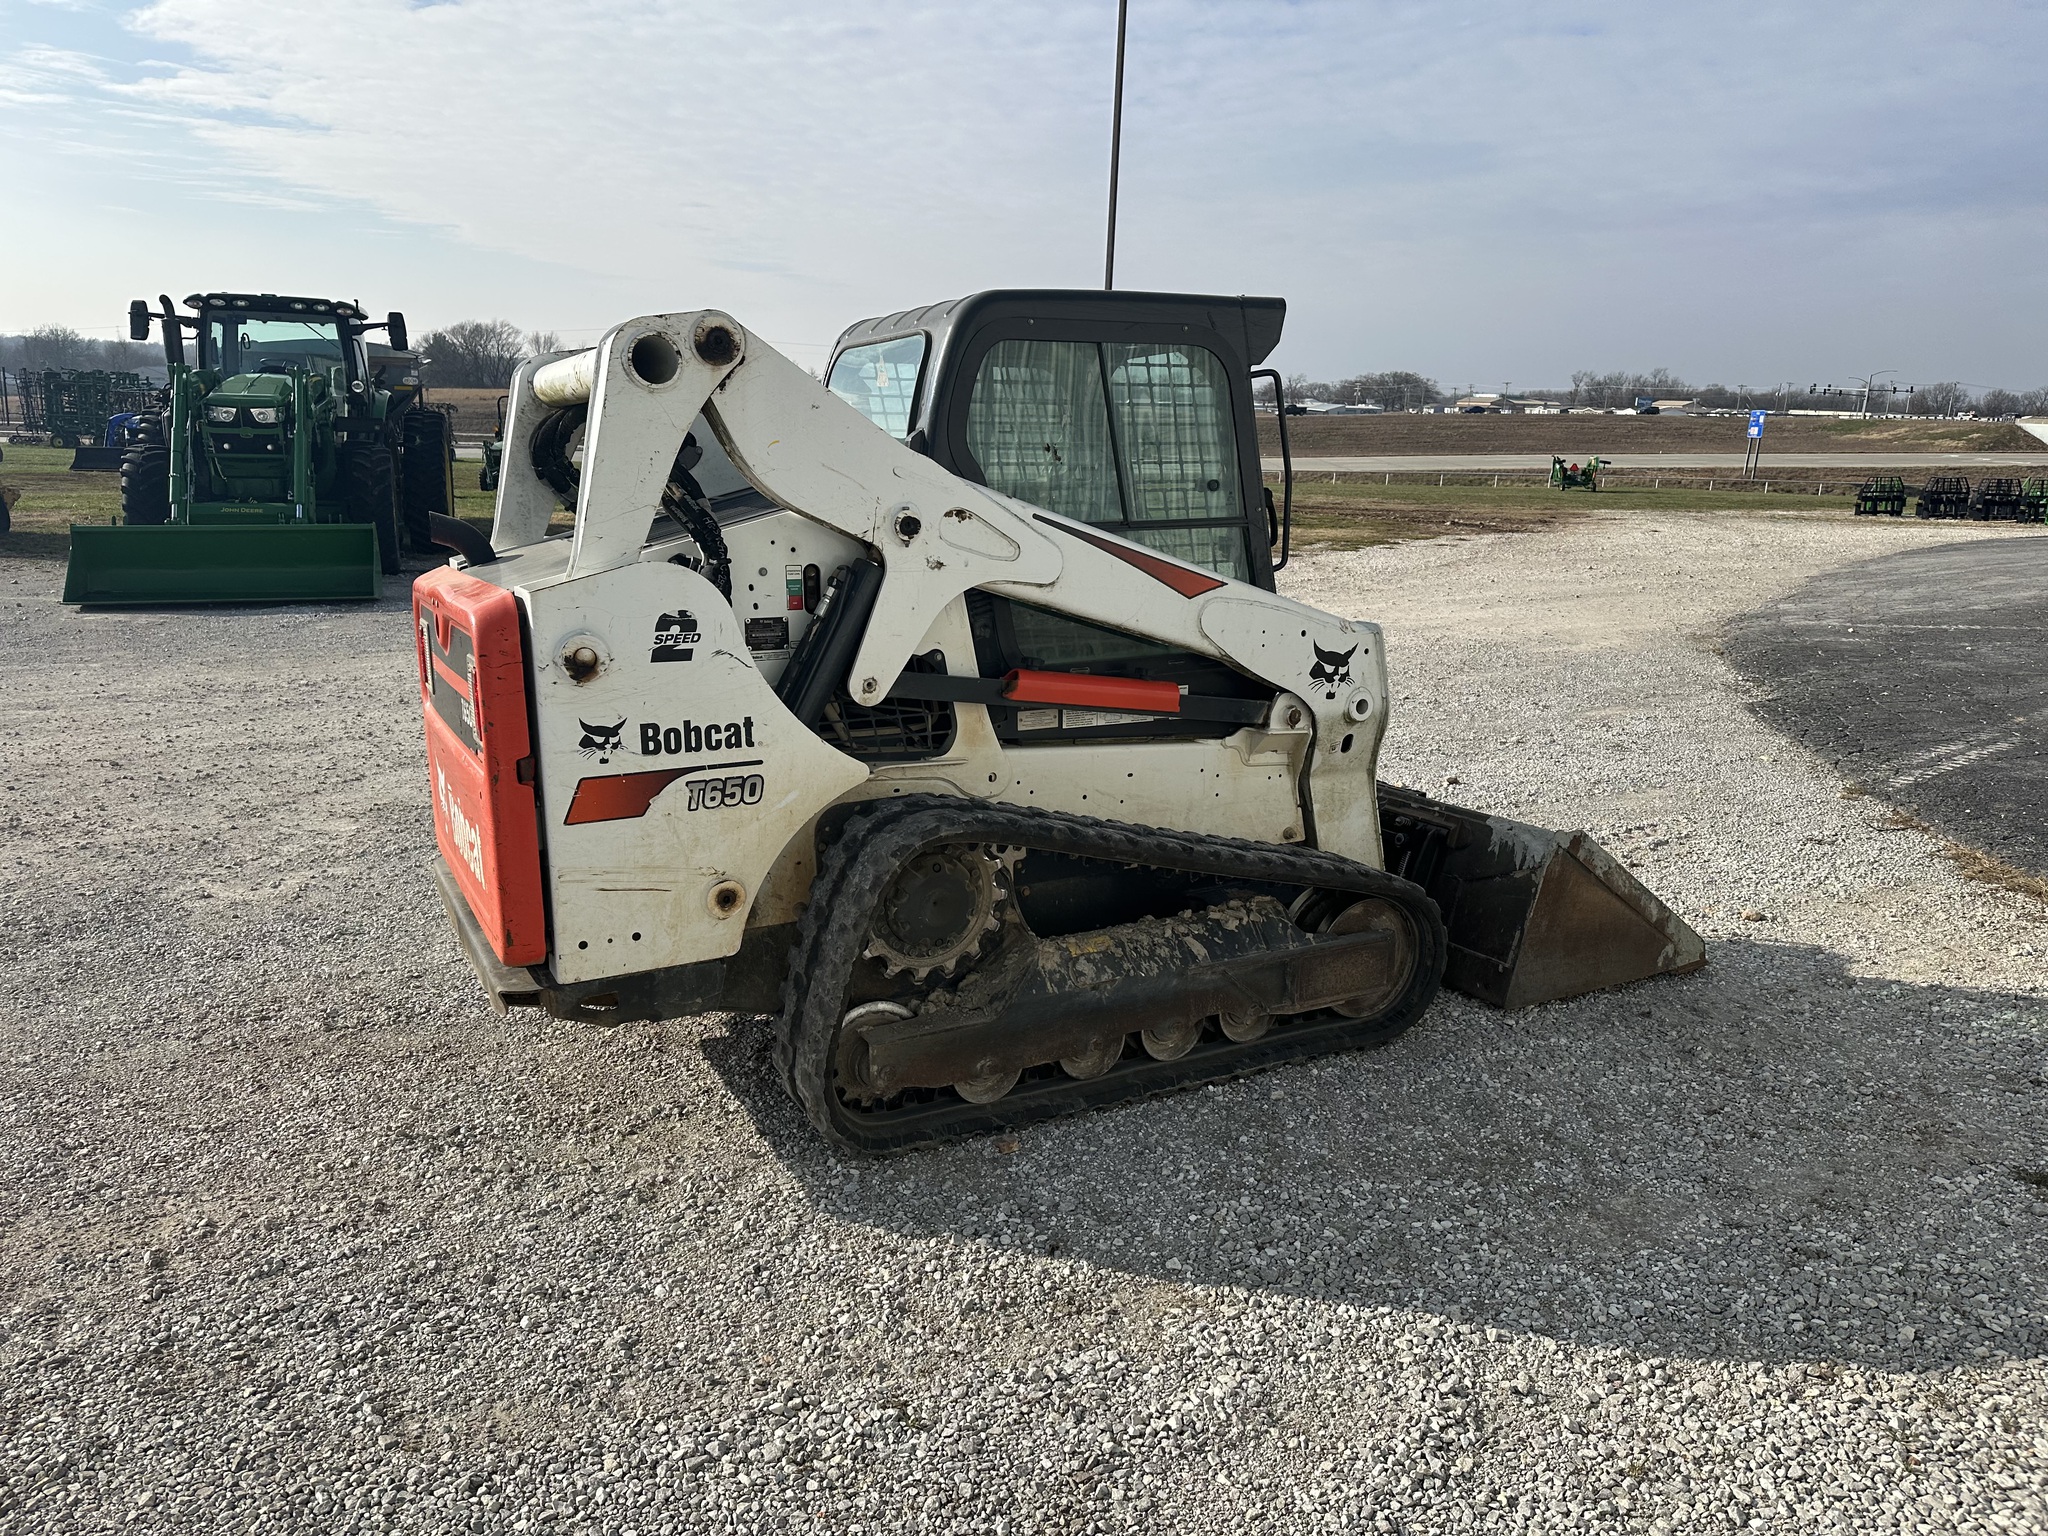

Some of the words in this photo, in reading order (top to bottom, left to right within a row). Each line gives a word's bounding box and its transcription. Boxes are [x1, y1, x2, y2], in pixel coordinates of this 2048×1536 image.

[650, 609, 698, 663] 2
[653, 632, 702, 646] SPEED
[639, 716, 755, 757] Bobcat
[685, 773, 765, 812] T650
